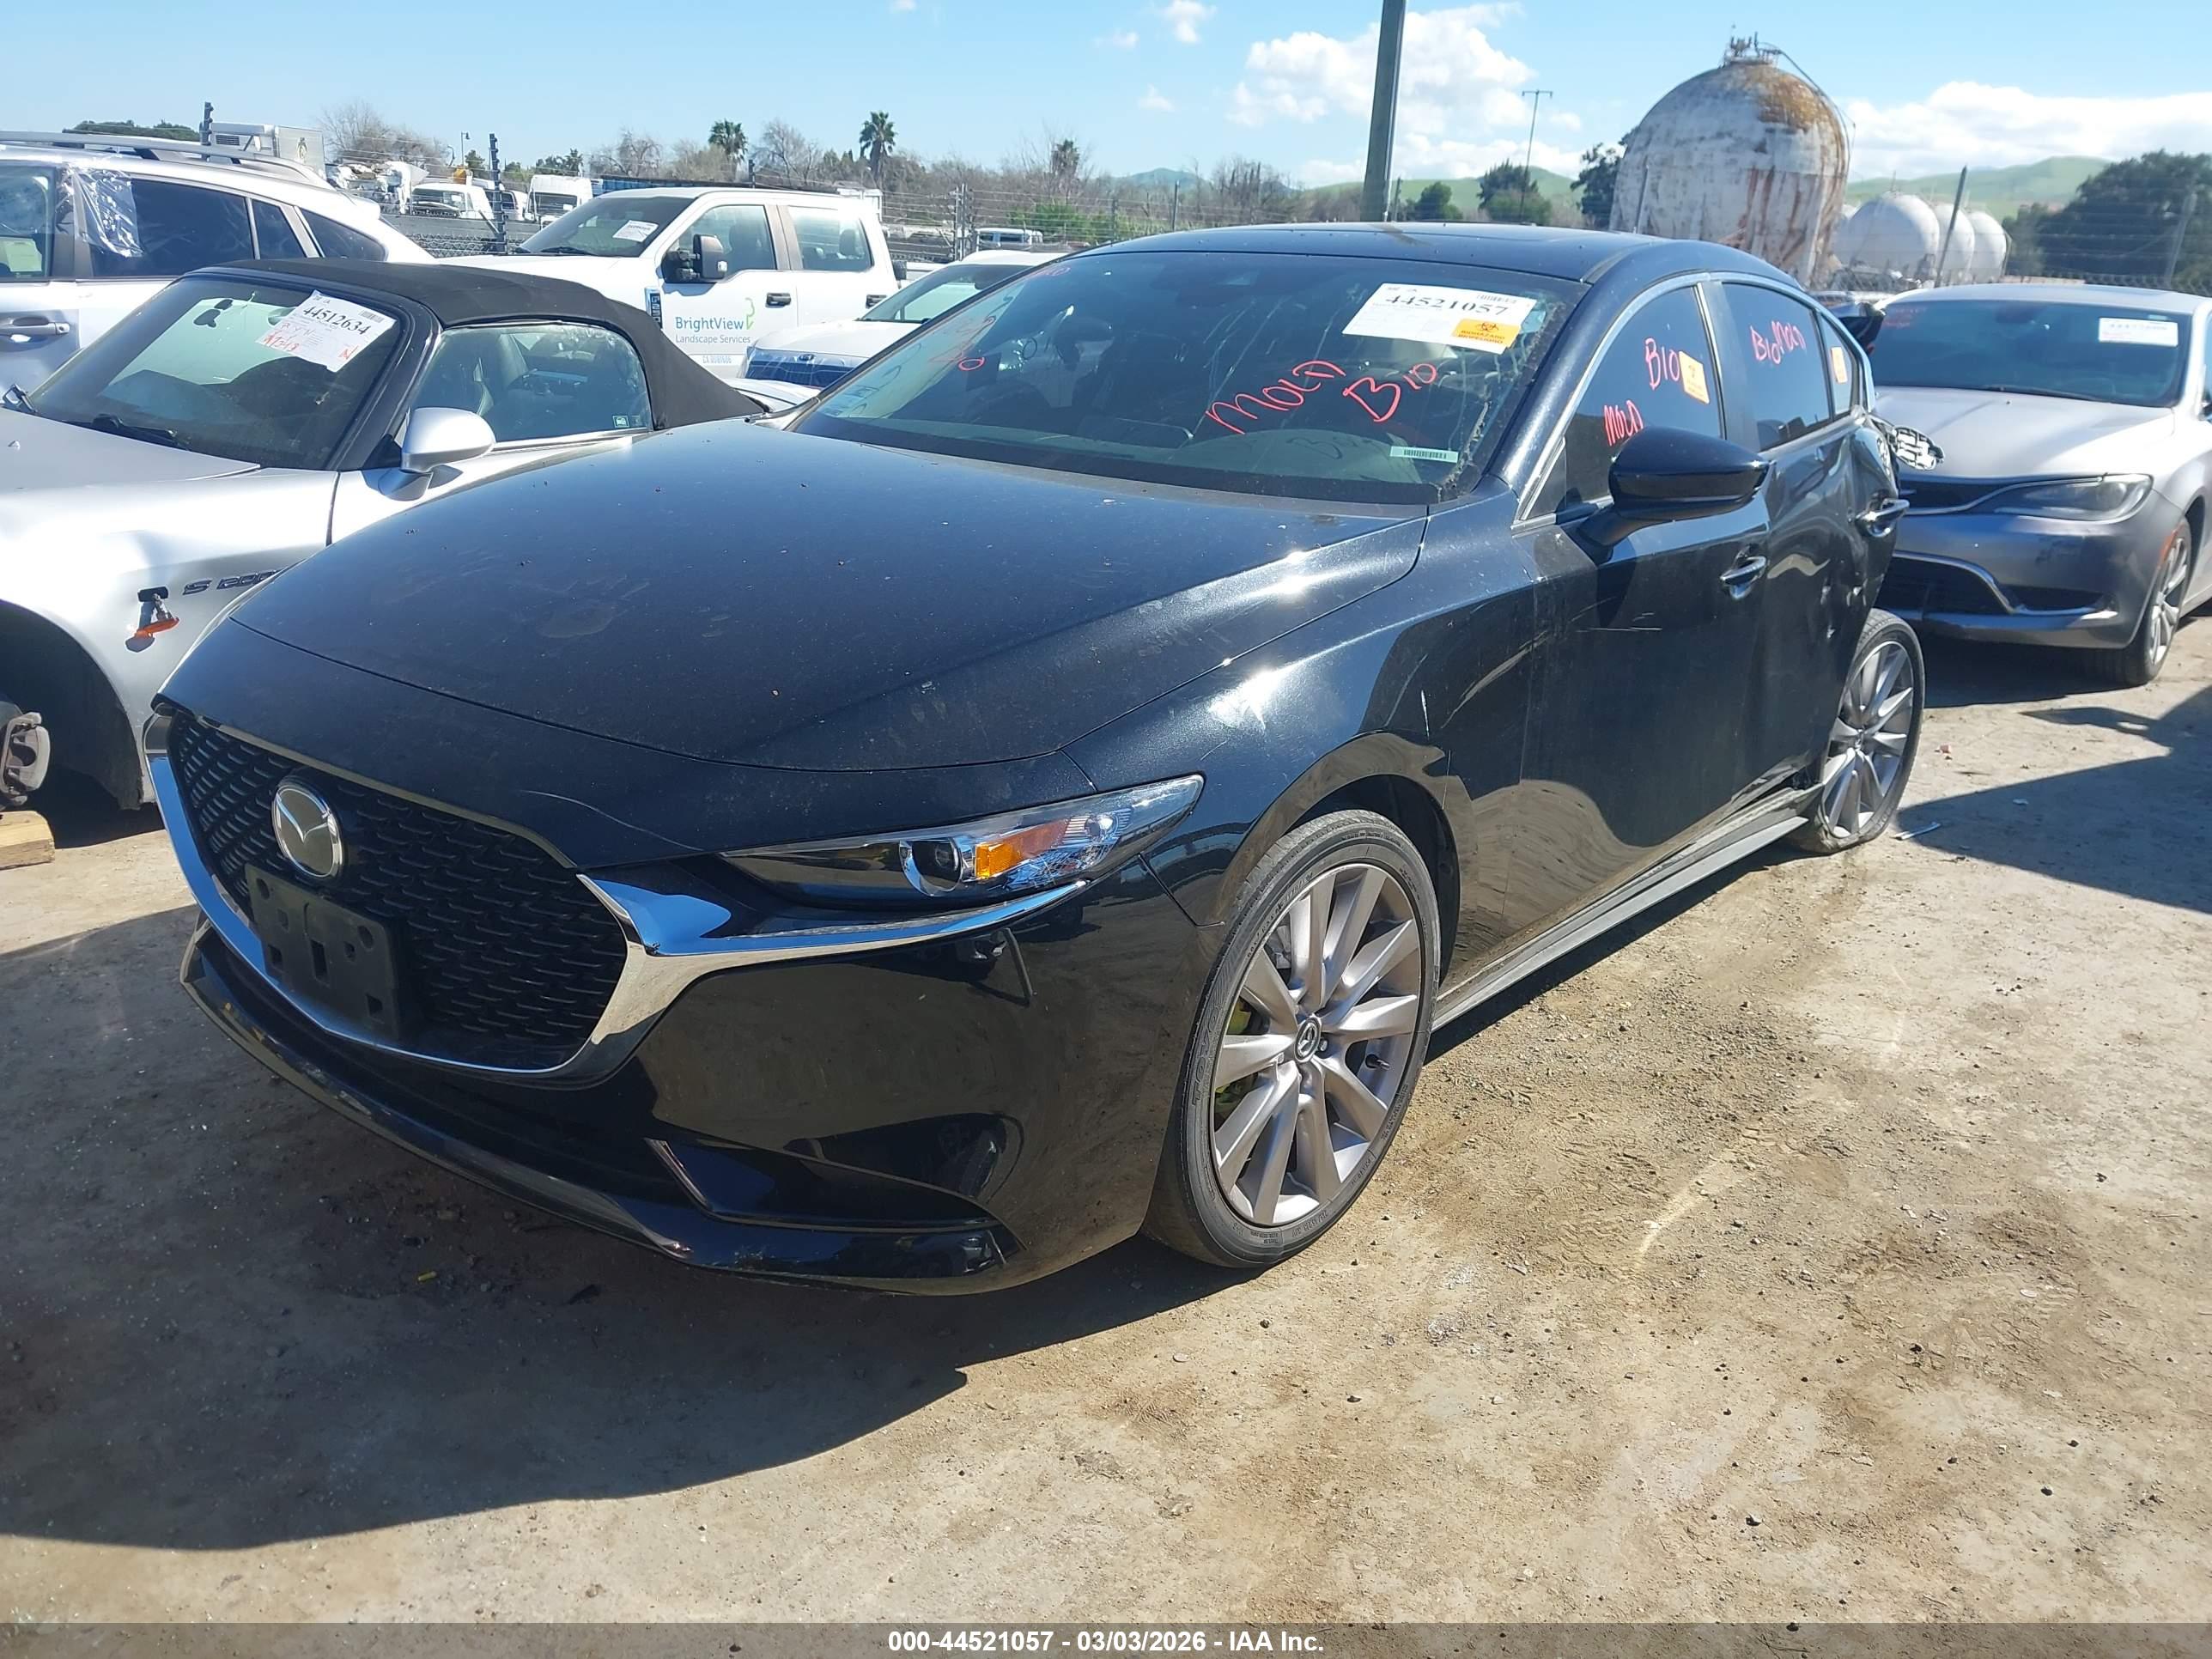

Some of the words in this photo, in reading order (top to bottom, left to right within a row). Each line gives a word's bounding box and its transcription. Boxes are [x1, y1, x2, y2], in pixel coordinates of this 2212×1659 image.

[1385, 295, 1509, 315] 44521057
[303, 306, 371, 335] 44512634
[676, 317, 744, 332] BrightView
[676, 335, 718, 343] Landscape
[720, 335, 750, 343] Services
[1645, 337, 1680, 390] BIO
[1206, 360, 1346, 435] MOLD
[182, 579, 213, 596] S
